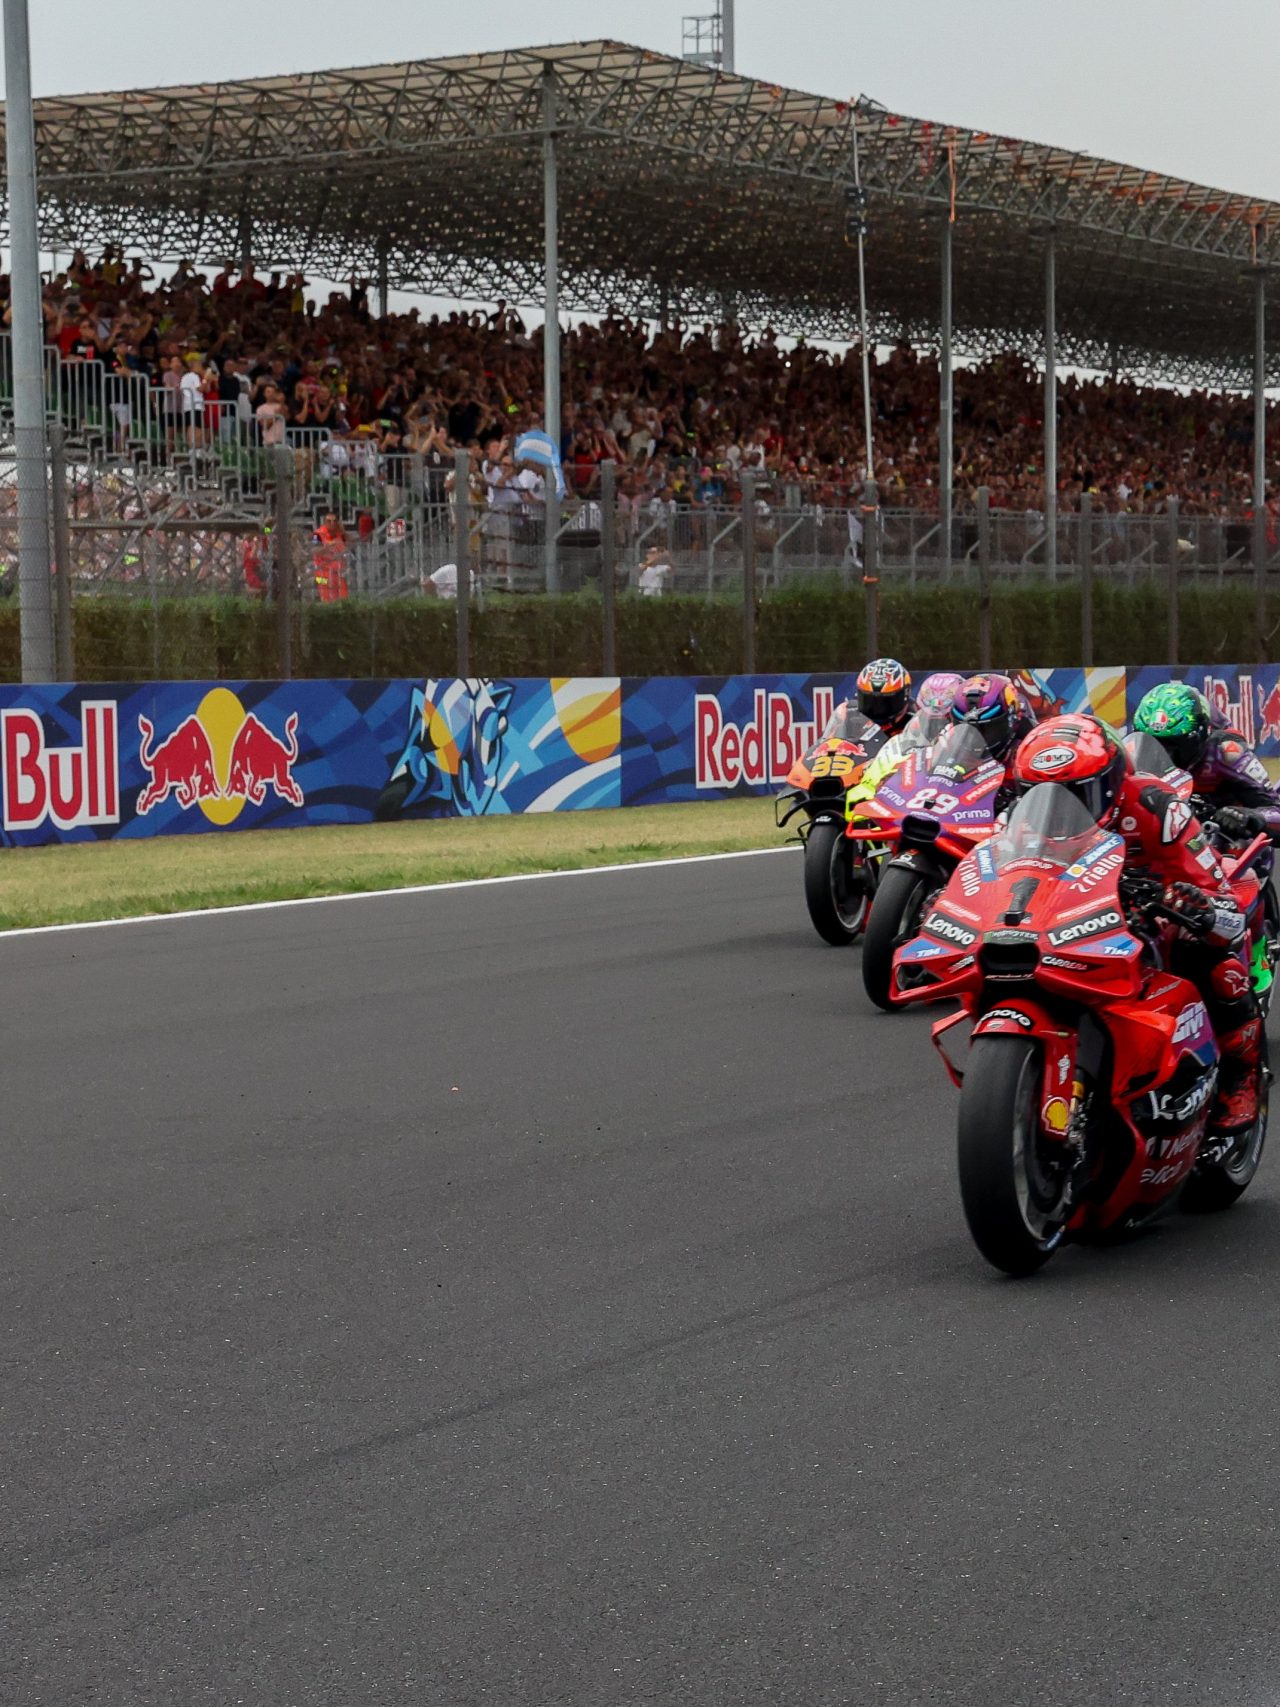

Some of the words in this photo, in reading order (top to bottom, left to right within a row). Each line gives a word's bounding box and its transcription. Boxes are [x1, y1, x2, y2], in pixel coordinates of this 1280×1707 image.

[695, 688, 766, 788] Red
[2, 702, 119, 829] Bull
[811, 755, 855, 777] 33
[879, 786, 906, 806] prima
[906, 788, 960, 814] 89
[952, 809, 991, 822] prima
[1085, 853, 1125, 888] riello
[924, 913, 976, 946] Lenovo
[1048, 912, 1121, 947] Lenovo
[916, 947, 941, 958] TIM
[1104, 946, 1130, 956] TIM
